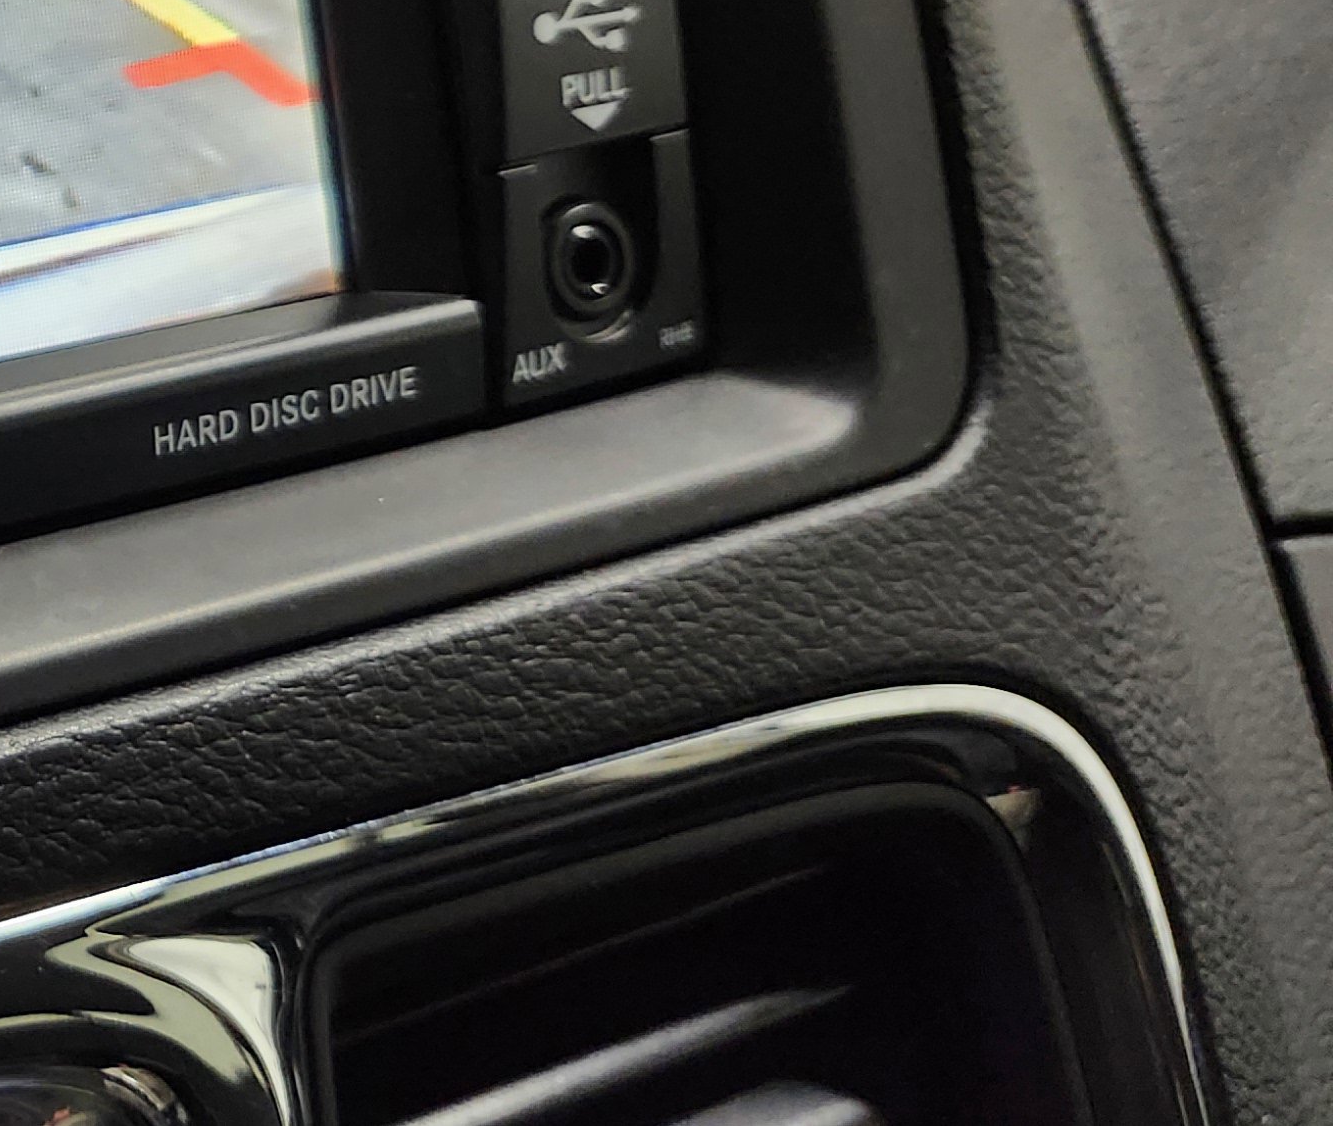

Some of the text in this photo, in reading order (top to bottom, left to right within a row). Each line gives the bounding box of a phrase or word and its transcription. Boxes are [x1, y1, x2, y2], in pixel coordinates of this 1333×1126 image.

[560, 66, 630, 108] PULL
[511, 342, 567, 383] AUX
[152, 365, 420, 457] HARD DISC DRIVE
